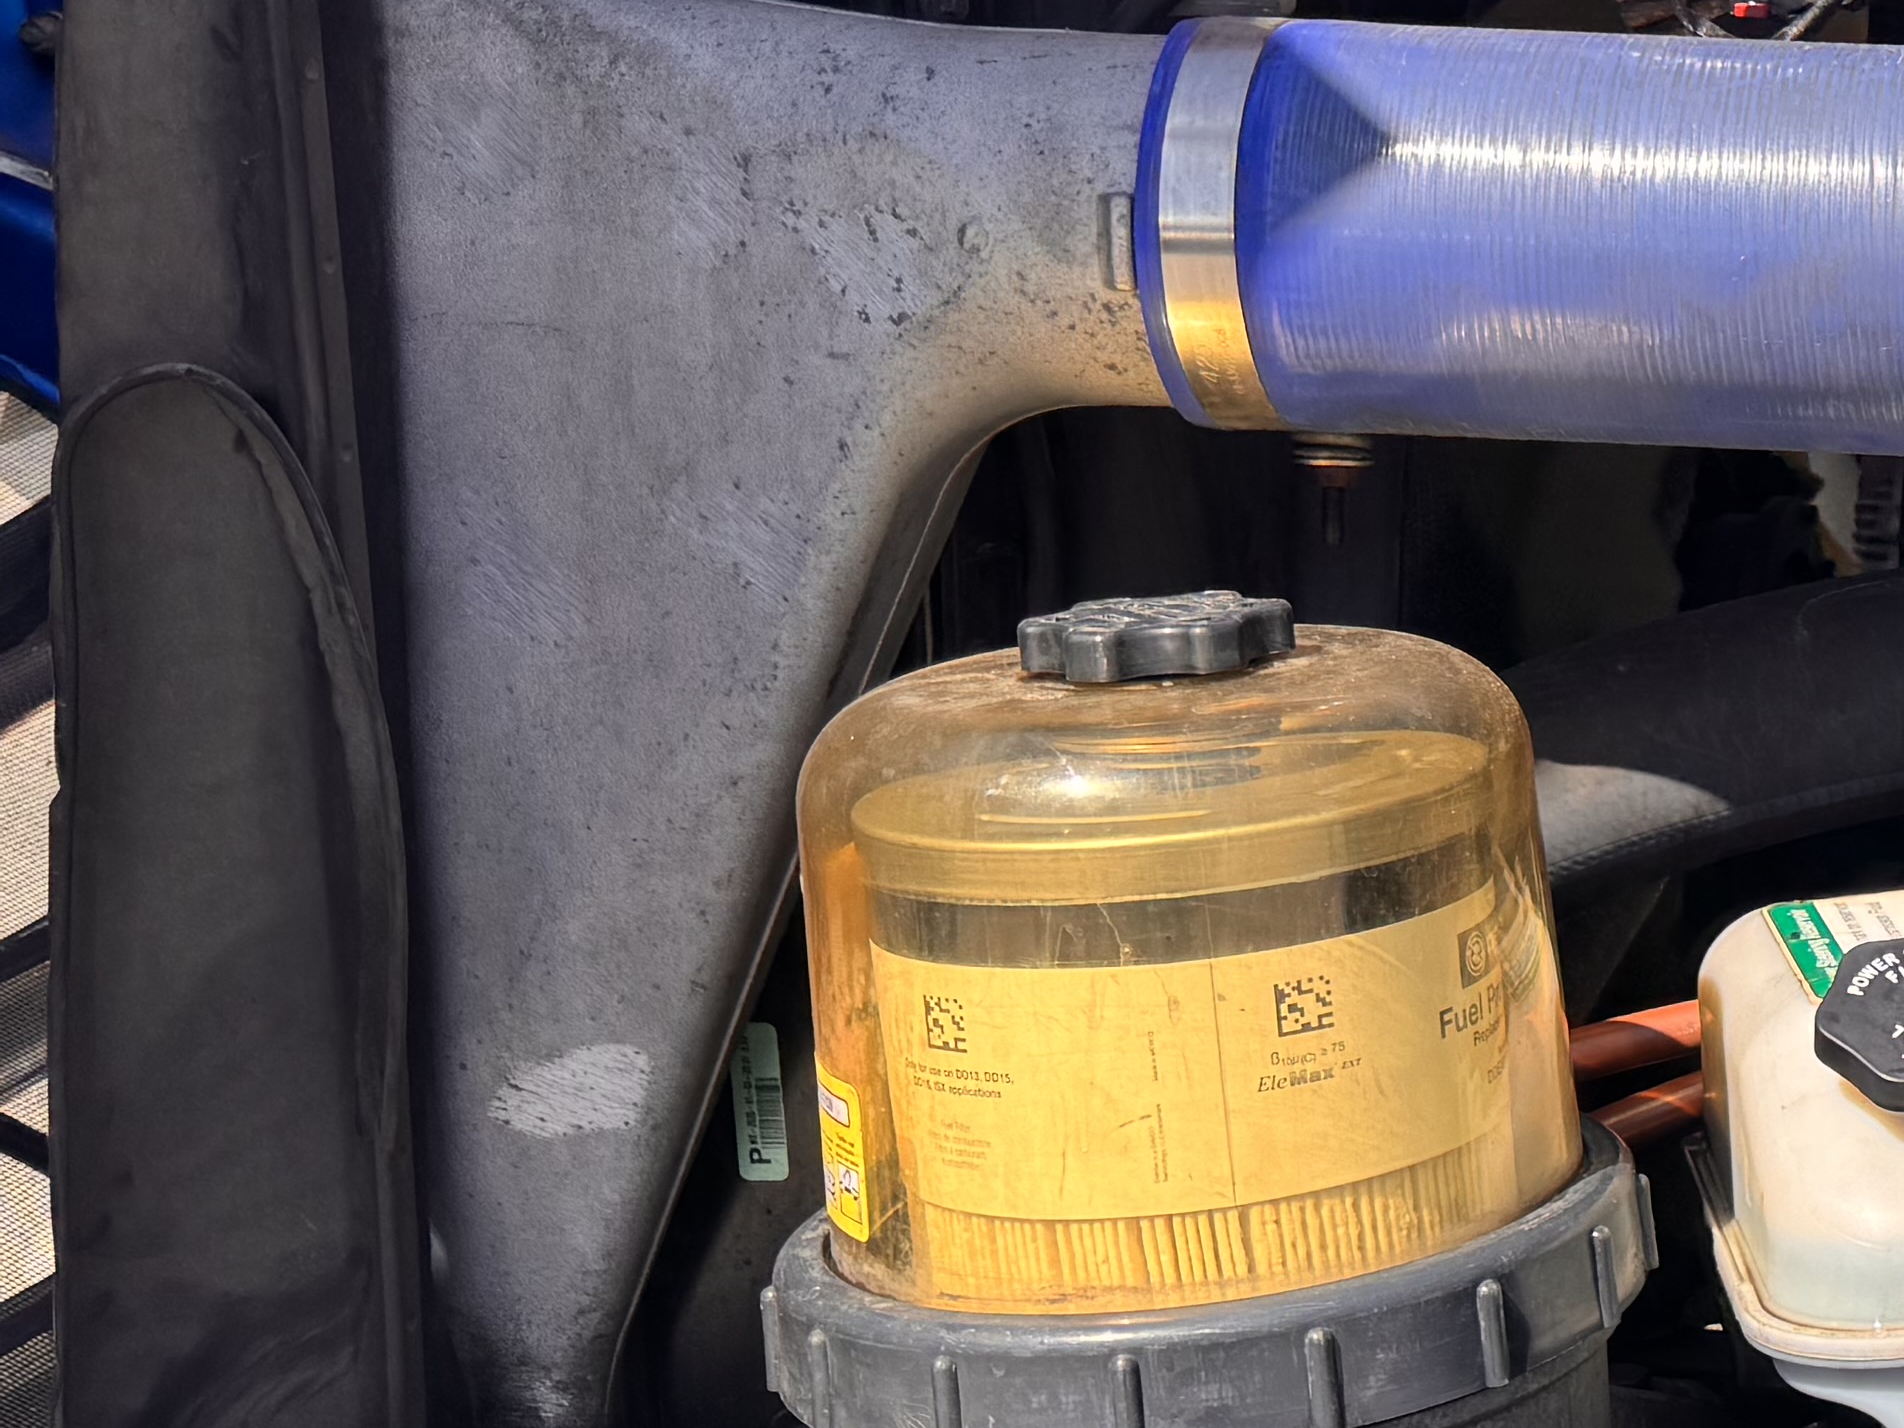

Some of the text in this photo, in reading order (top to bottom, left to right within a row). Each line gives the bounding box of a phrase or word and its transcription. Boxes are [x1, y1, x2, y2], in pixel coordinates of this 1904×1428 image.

[1847, 952, 1900, 996] POWER
[1439, 993, 1483, 1039] Fuel
[1331, 1040, 1346, 1053] 75
[1258, 1066, 1335, 1093] EleMax
